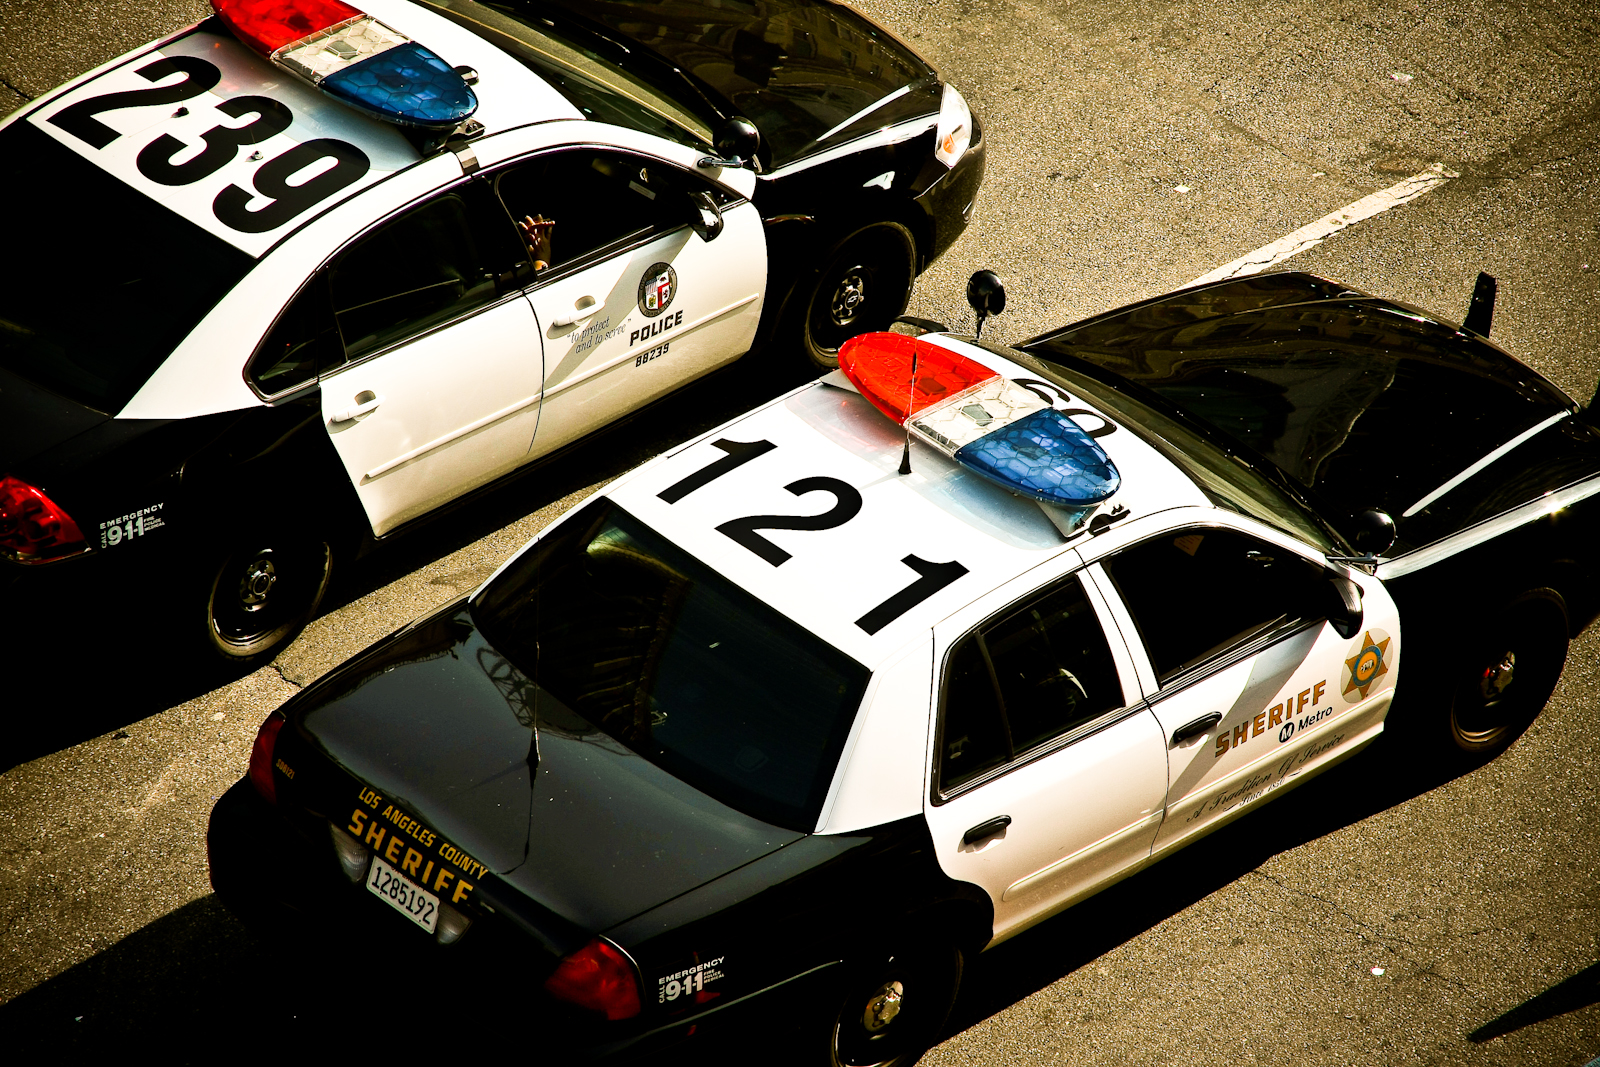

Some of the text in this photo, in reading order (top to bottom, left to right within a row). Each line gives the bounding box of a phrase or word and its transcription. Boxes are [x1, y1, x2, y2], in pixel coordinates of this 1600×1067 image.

[47, 54, 371, 233] 239
[581, 316, 610, 342] protect
[629, 309, 684, 347] POLICE
[576, 336, 593, 354] and
[595, 334, 604, 345] to
[635, 342, 670, 368] 88239
[100, 502, 164, 530] EMERGENCY
[107, 516, 145, 546] 9-1-1
[1215, 679, 1327, 758] SHERIFF
[1297, 706, 1333, 732] Metro
[1186, 733, 1345, 823] A Tradition Of Service
[1238, 788, 1264, 807] Since
[358, 786, 382, 810] LOS
[381, 804, 437, 848] ANGELES
[438, 841, 490, 881] COUNTY
[347, 808, 474, 904] SHERIFF
[371, 866, 436, 926] 1285192
[658, 955, 725, 985] EMERGENCY
[703, 968, 715, 976] FIRE
[658, 971, 704, 1004] CALL 9-1-1
